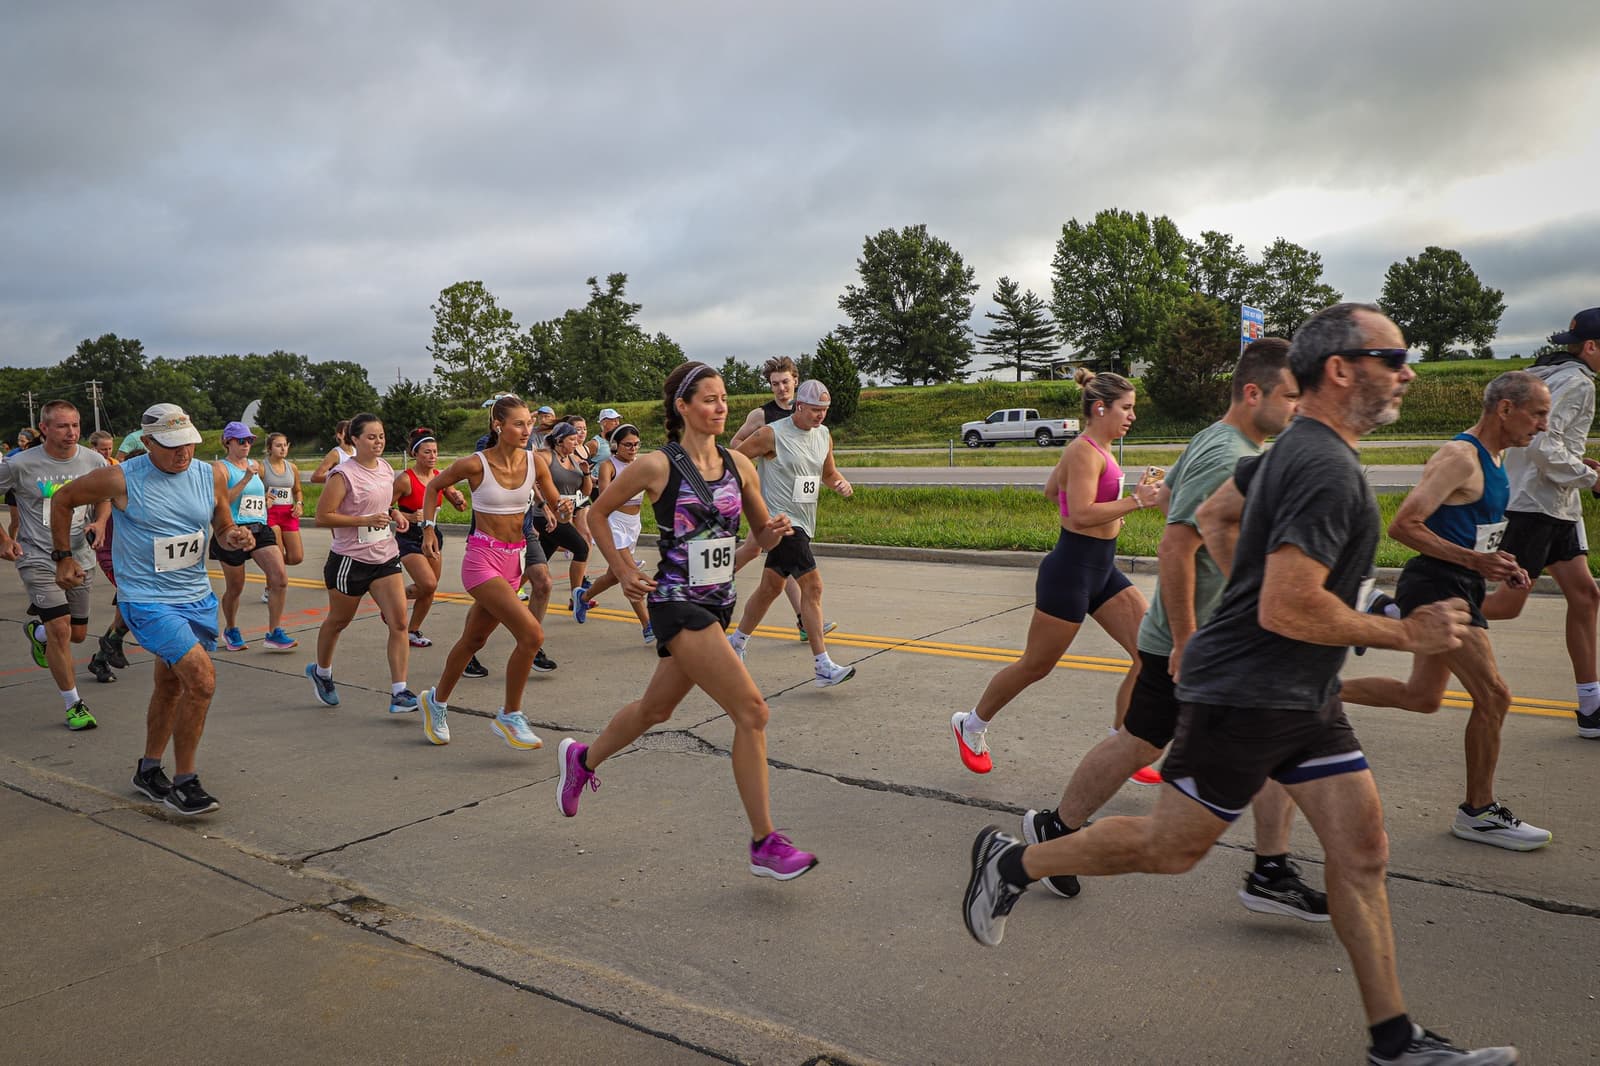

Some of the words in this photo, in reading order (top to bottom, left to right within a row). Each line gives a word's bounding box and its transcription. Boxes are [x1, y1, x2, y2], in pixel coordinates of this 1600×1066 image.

[803, 481, 815, 494] 83
[245, 499, 263, 510] 213
[165, 539, 199, 559] 174
[700, 547, 731, 569] 195
